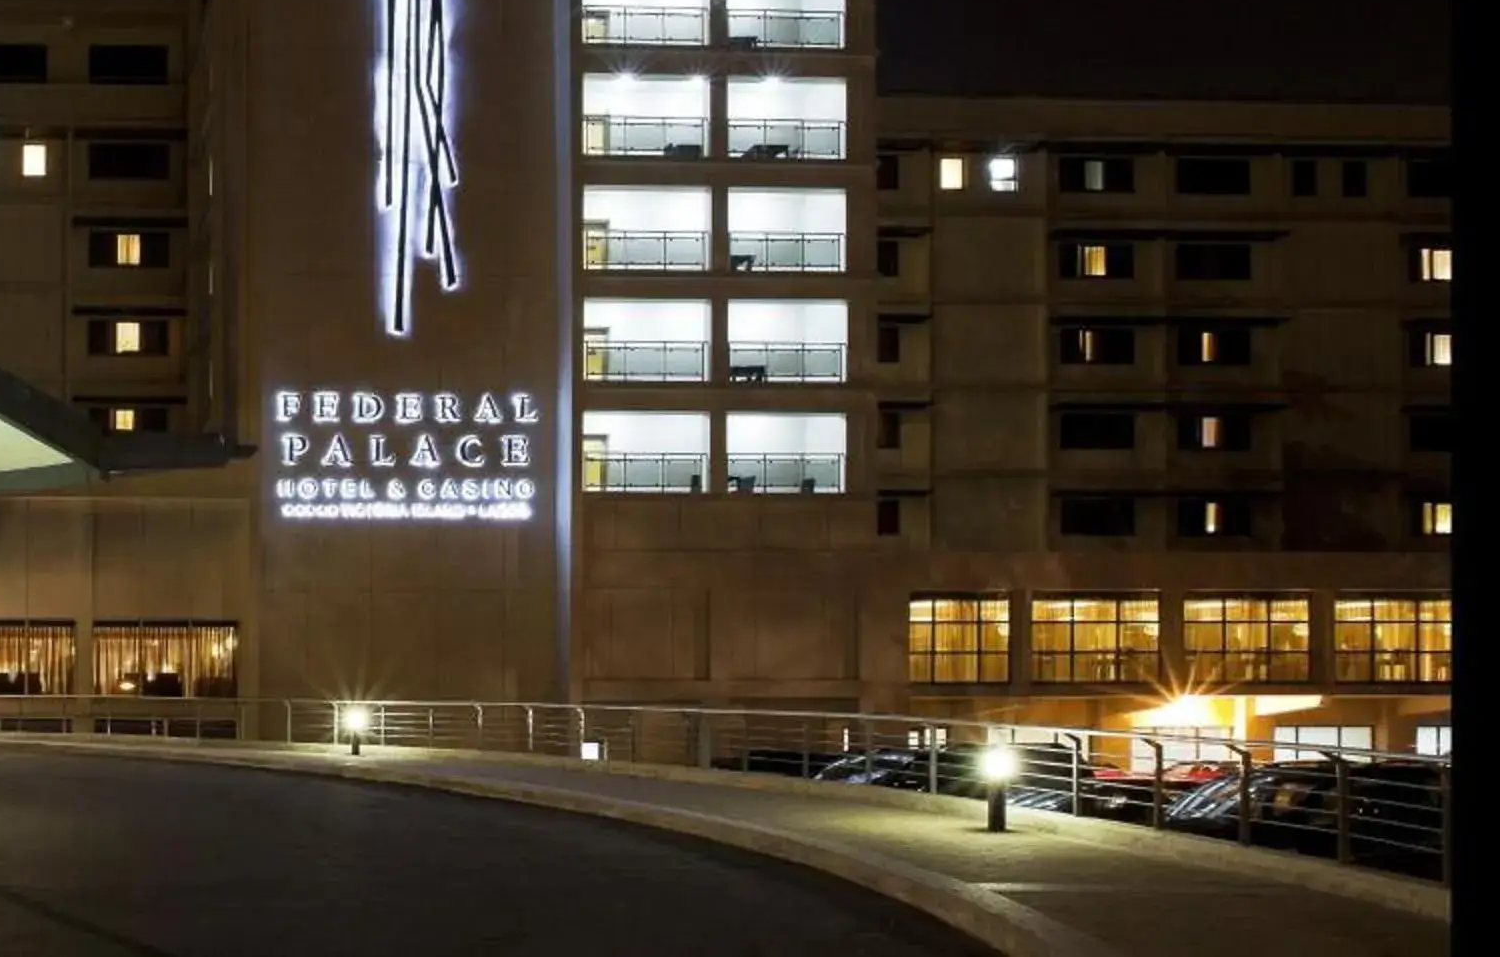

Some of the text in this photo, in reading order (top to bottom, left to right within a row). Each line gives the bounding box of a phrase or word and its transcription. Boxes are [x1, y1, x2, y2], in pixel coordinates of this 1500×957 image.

[275, 391, 539, 423] FEDERAL
[280, 433, 531, 467] PALACE
[276, 478, 536, 499] HOTEL & CASINO
